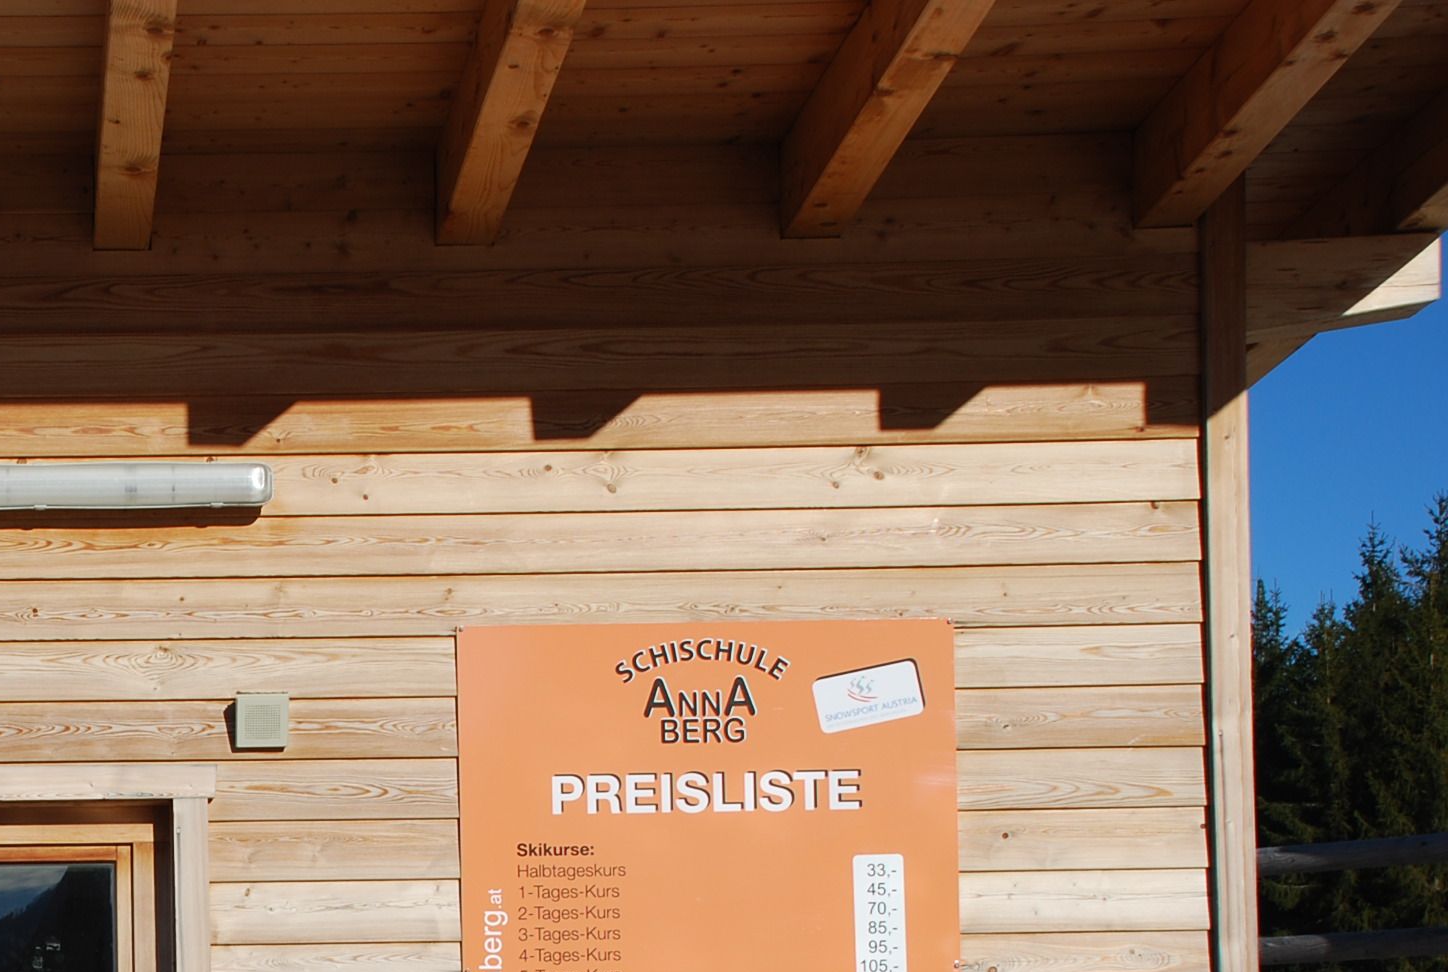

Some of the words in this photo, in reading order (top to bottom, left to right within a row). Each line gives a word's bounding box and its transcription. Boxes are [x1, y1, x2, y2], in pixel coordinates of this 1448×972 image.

[615, 638, 791, 684] SCHISCHULE
[823, 704, 879, 722] SNOWSPORT
[880, 697, 918, 711] AUSTRIA
[659, 716, 747, 744] BERG
[551, 769, 863, 816] PREISLISTE
[517, 843, 594, 857] Skikurse:
[518, 864, 626, 880] Halbtageskurs
[867, 863, 896, 878] 33,-
[520, 885, 620, 902] 1-Tages-Kurs
[867, 882, 896, 897] 45,-
[518, 906, 620, 923] 2-Tages-Kurs
[868, 902, 897, 916] 70,-
[519, 927, 621, 944] 3-Tages-Kurs
[868, 921, 898, 936] 85,-
[868, 940, 898, 954] 95,-
[519, 948, 621, 965] 4-Tages-Kurs
